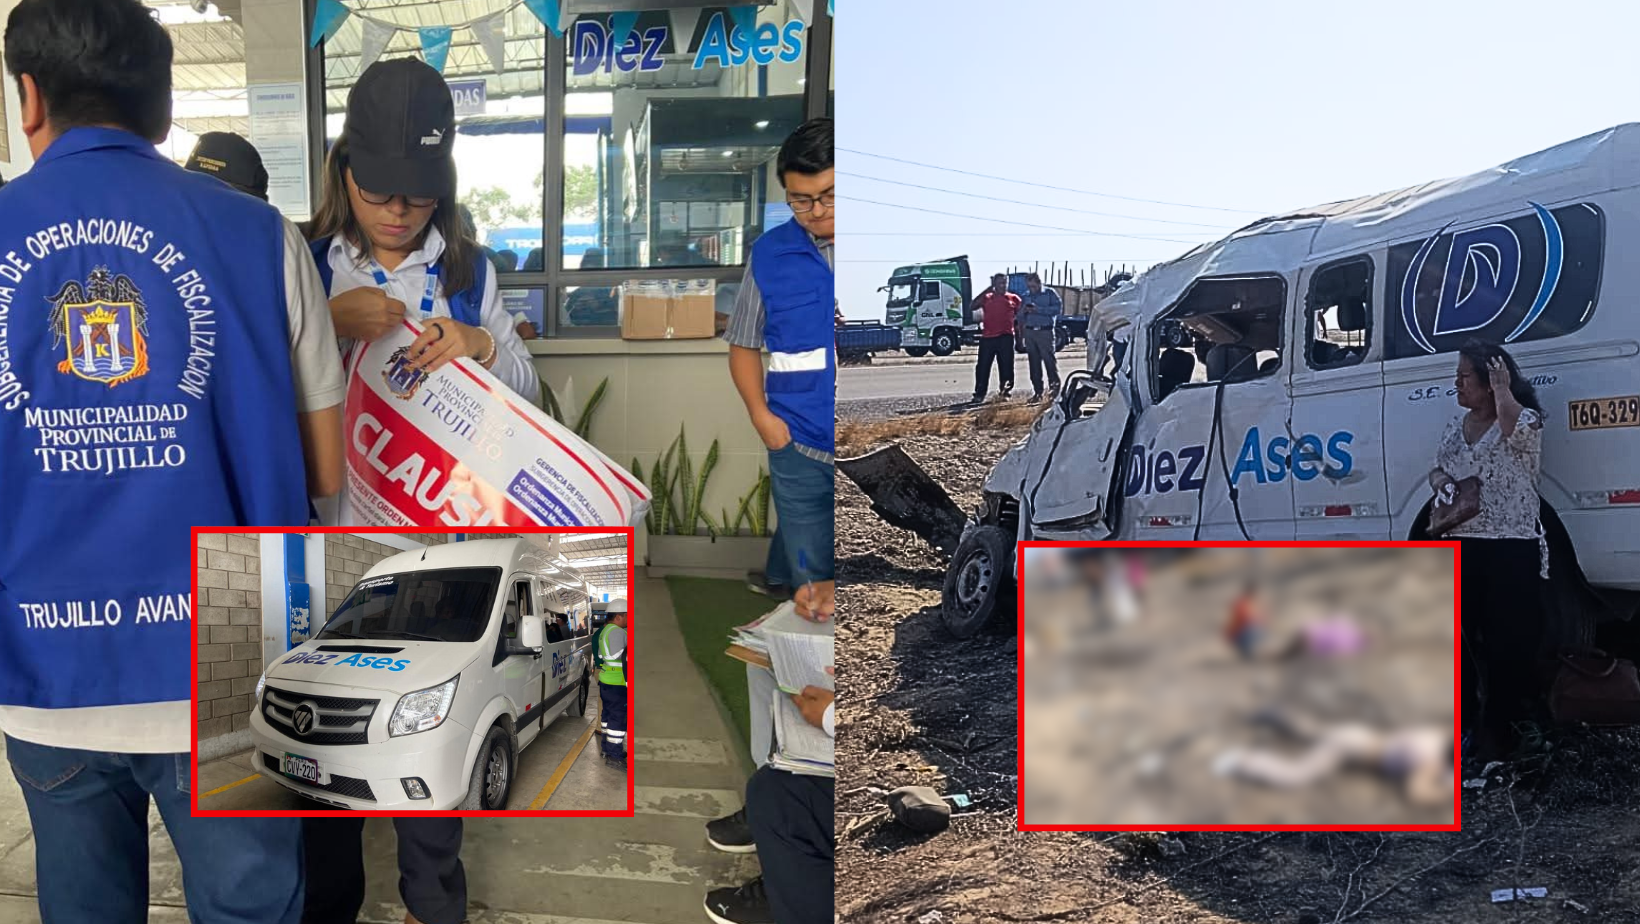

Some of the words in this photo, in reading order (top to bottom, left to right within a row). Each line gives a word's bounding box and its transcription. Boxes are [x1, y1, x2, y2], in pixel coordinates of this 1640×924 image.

[572, 17, 668, 76] Diez
[691, 12, 806, 70] Ases
[0, 251, 31, 283] DE
[26, 218, 154, 259] OPERACIONES
[152, 243, 185, 273] DE
[172, 269, 216, 400] FISCALIZACION
[95, 343, 109, 357] K
[24, 404, 187, 428] MUNICIPALIDAD
[1571, 399, 1638, 427] T6Q-329
[40, 426, 156, 446] PROVINCIAL
[160, 427, 176, 438] DE
[34, 444, 186, 475] TRUJILLO
[353, 412, 505, 526] CLAUS
[1124, 438, 1205, 497] Diez
[1231, 427, 1354, 484] Ases
[535, 456, 568, 487] GERENCIA
[565, 483, 576, 494] DE
[519, 476, 555, 510] Ordenanza
[375, 499, 404, 526] ORDEN
[19, 599, 122, 628] TRUJILLO
[282, 650, 337, 665] Diez
[334, 653, 411, 672] Ases
[287, 760, 316, 780] CVY-220
